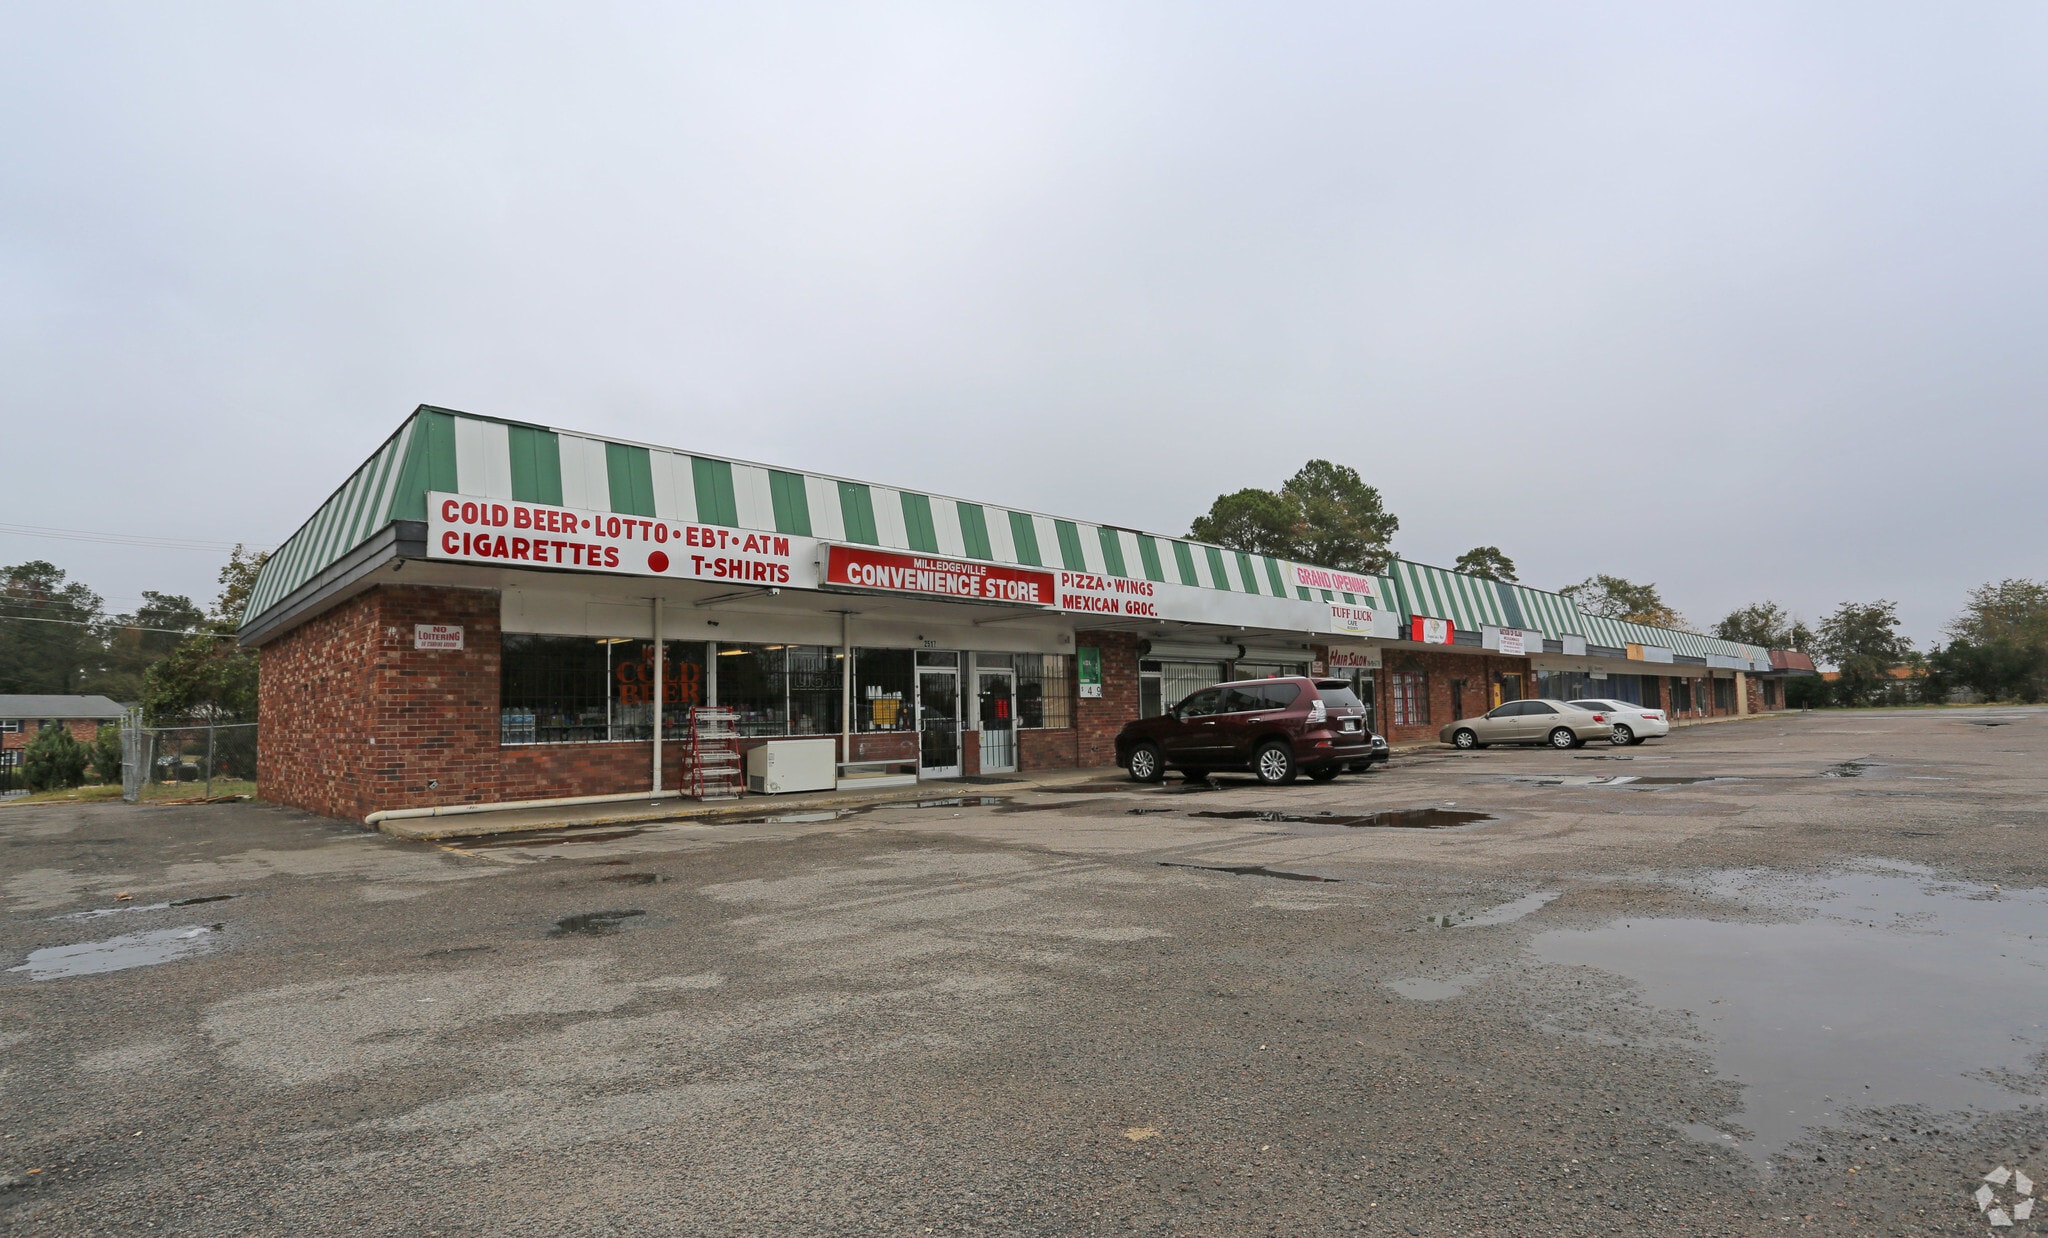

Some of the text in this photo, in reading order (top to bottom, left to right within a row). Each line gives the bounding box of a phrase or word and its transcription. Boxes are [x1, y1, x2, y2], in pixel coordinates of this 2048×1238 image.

[442, 499, 790, 557] COLD BEER LOTTO EBT ATM
[442, 531, 620, 568] CIGARETTES
[691, 555, 790, 583] T-SHIRTS
[913, 558, 987, 576] MILLEDGEVILLE
[847, 563, 1040, 602] CONVENIENCE STORE
[1062, 572, 1154, 597] PIZZA WINGS
[1297, 567, 1370, 594] GRAND OPENING
[1062, 594, 1158, 617] MEXICAN GROC.
[1331, 606, 1372, 622] TUFF LUCK
[418, 631, 459, 640] LOITERING
[616, 661, 700, 683] COLD
[618, 682, 700, 705] BEER
